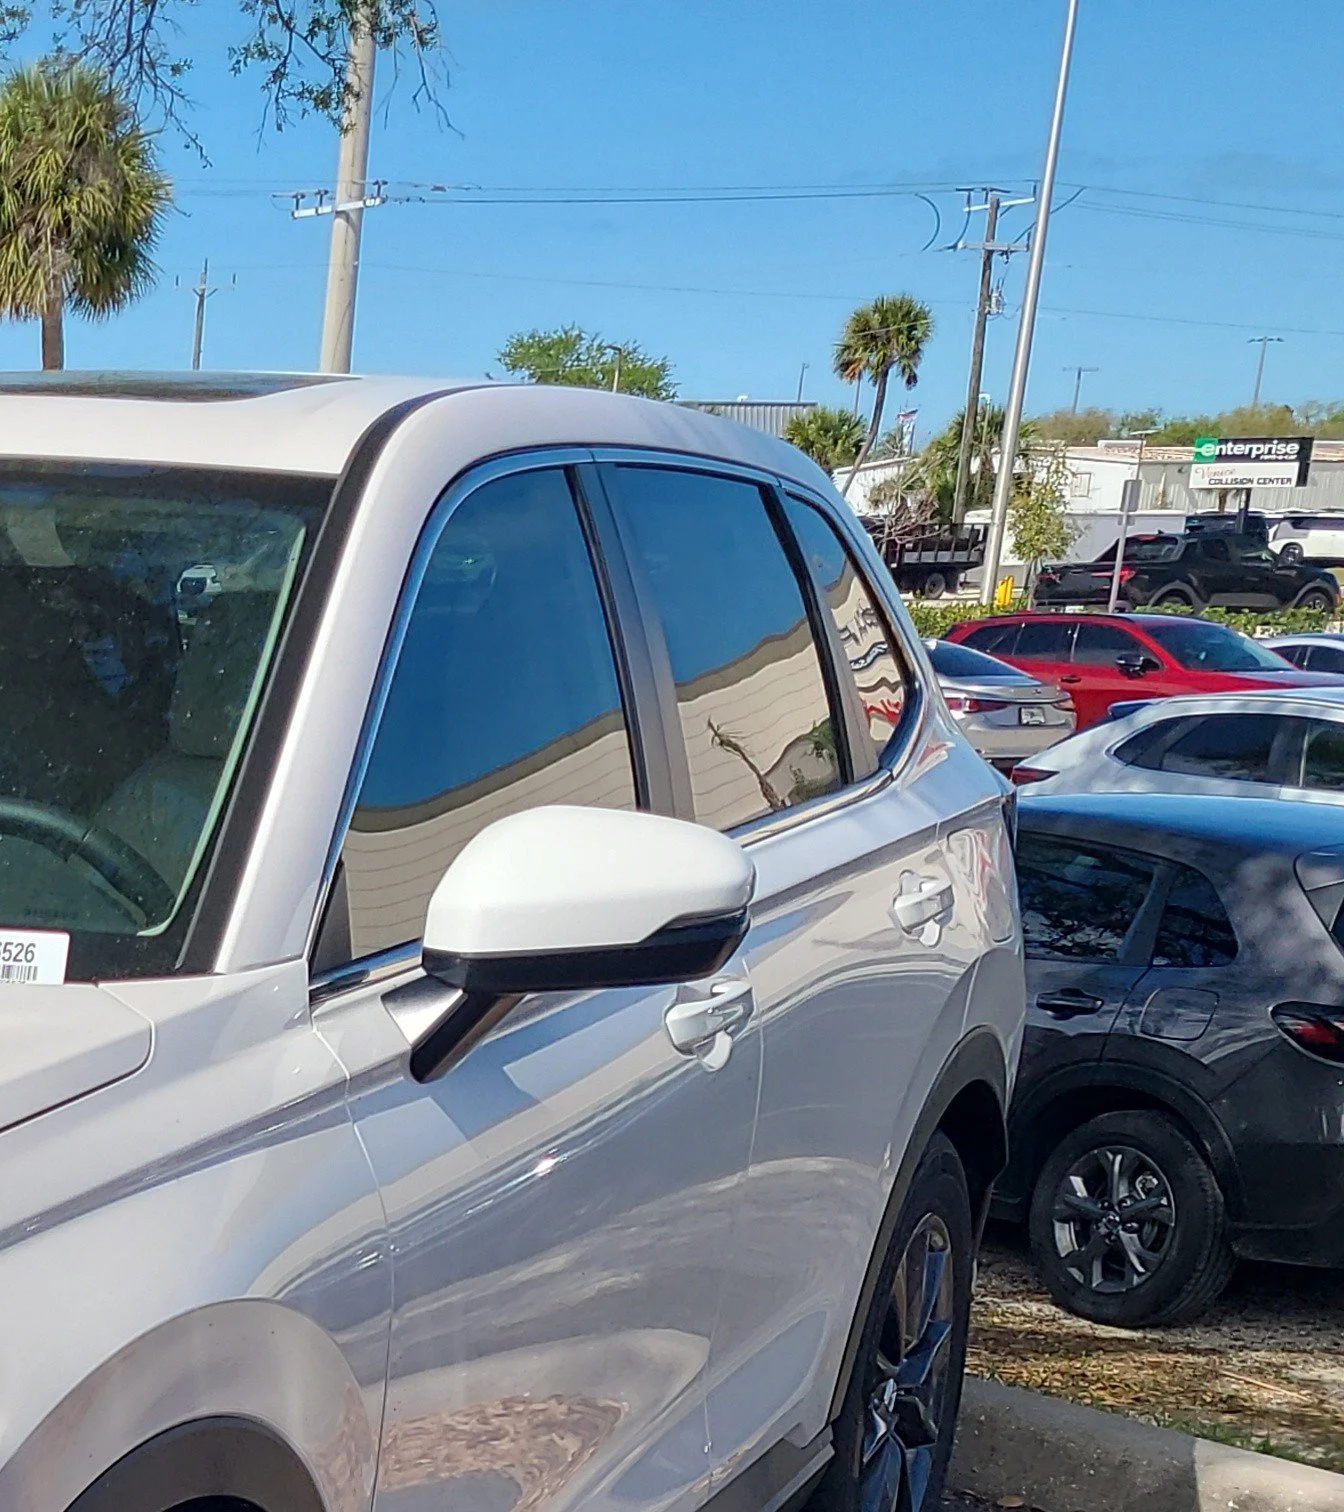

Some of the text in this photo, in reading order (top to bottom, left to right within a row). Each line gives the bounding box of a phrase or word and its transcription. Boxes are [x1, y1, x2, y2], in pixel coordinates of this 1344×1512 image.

[1198, 440, 1300, 459] enterprise
[1208, 477, 1293, 486] COLLISION CENTER
